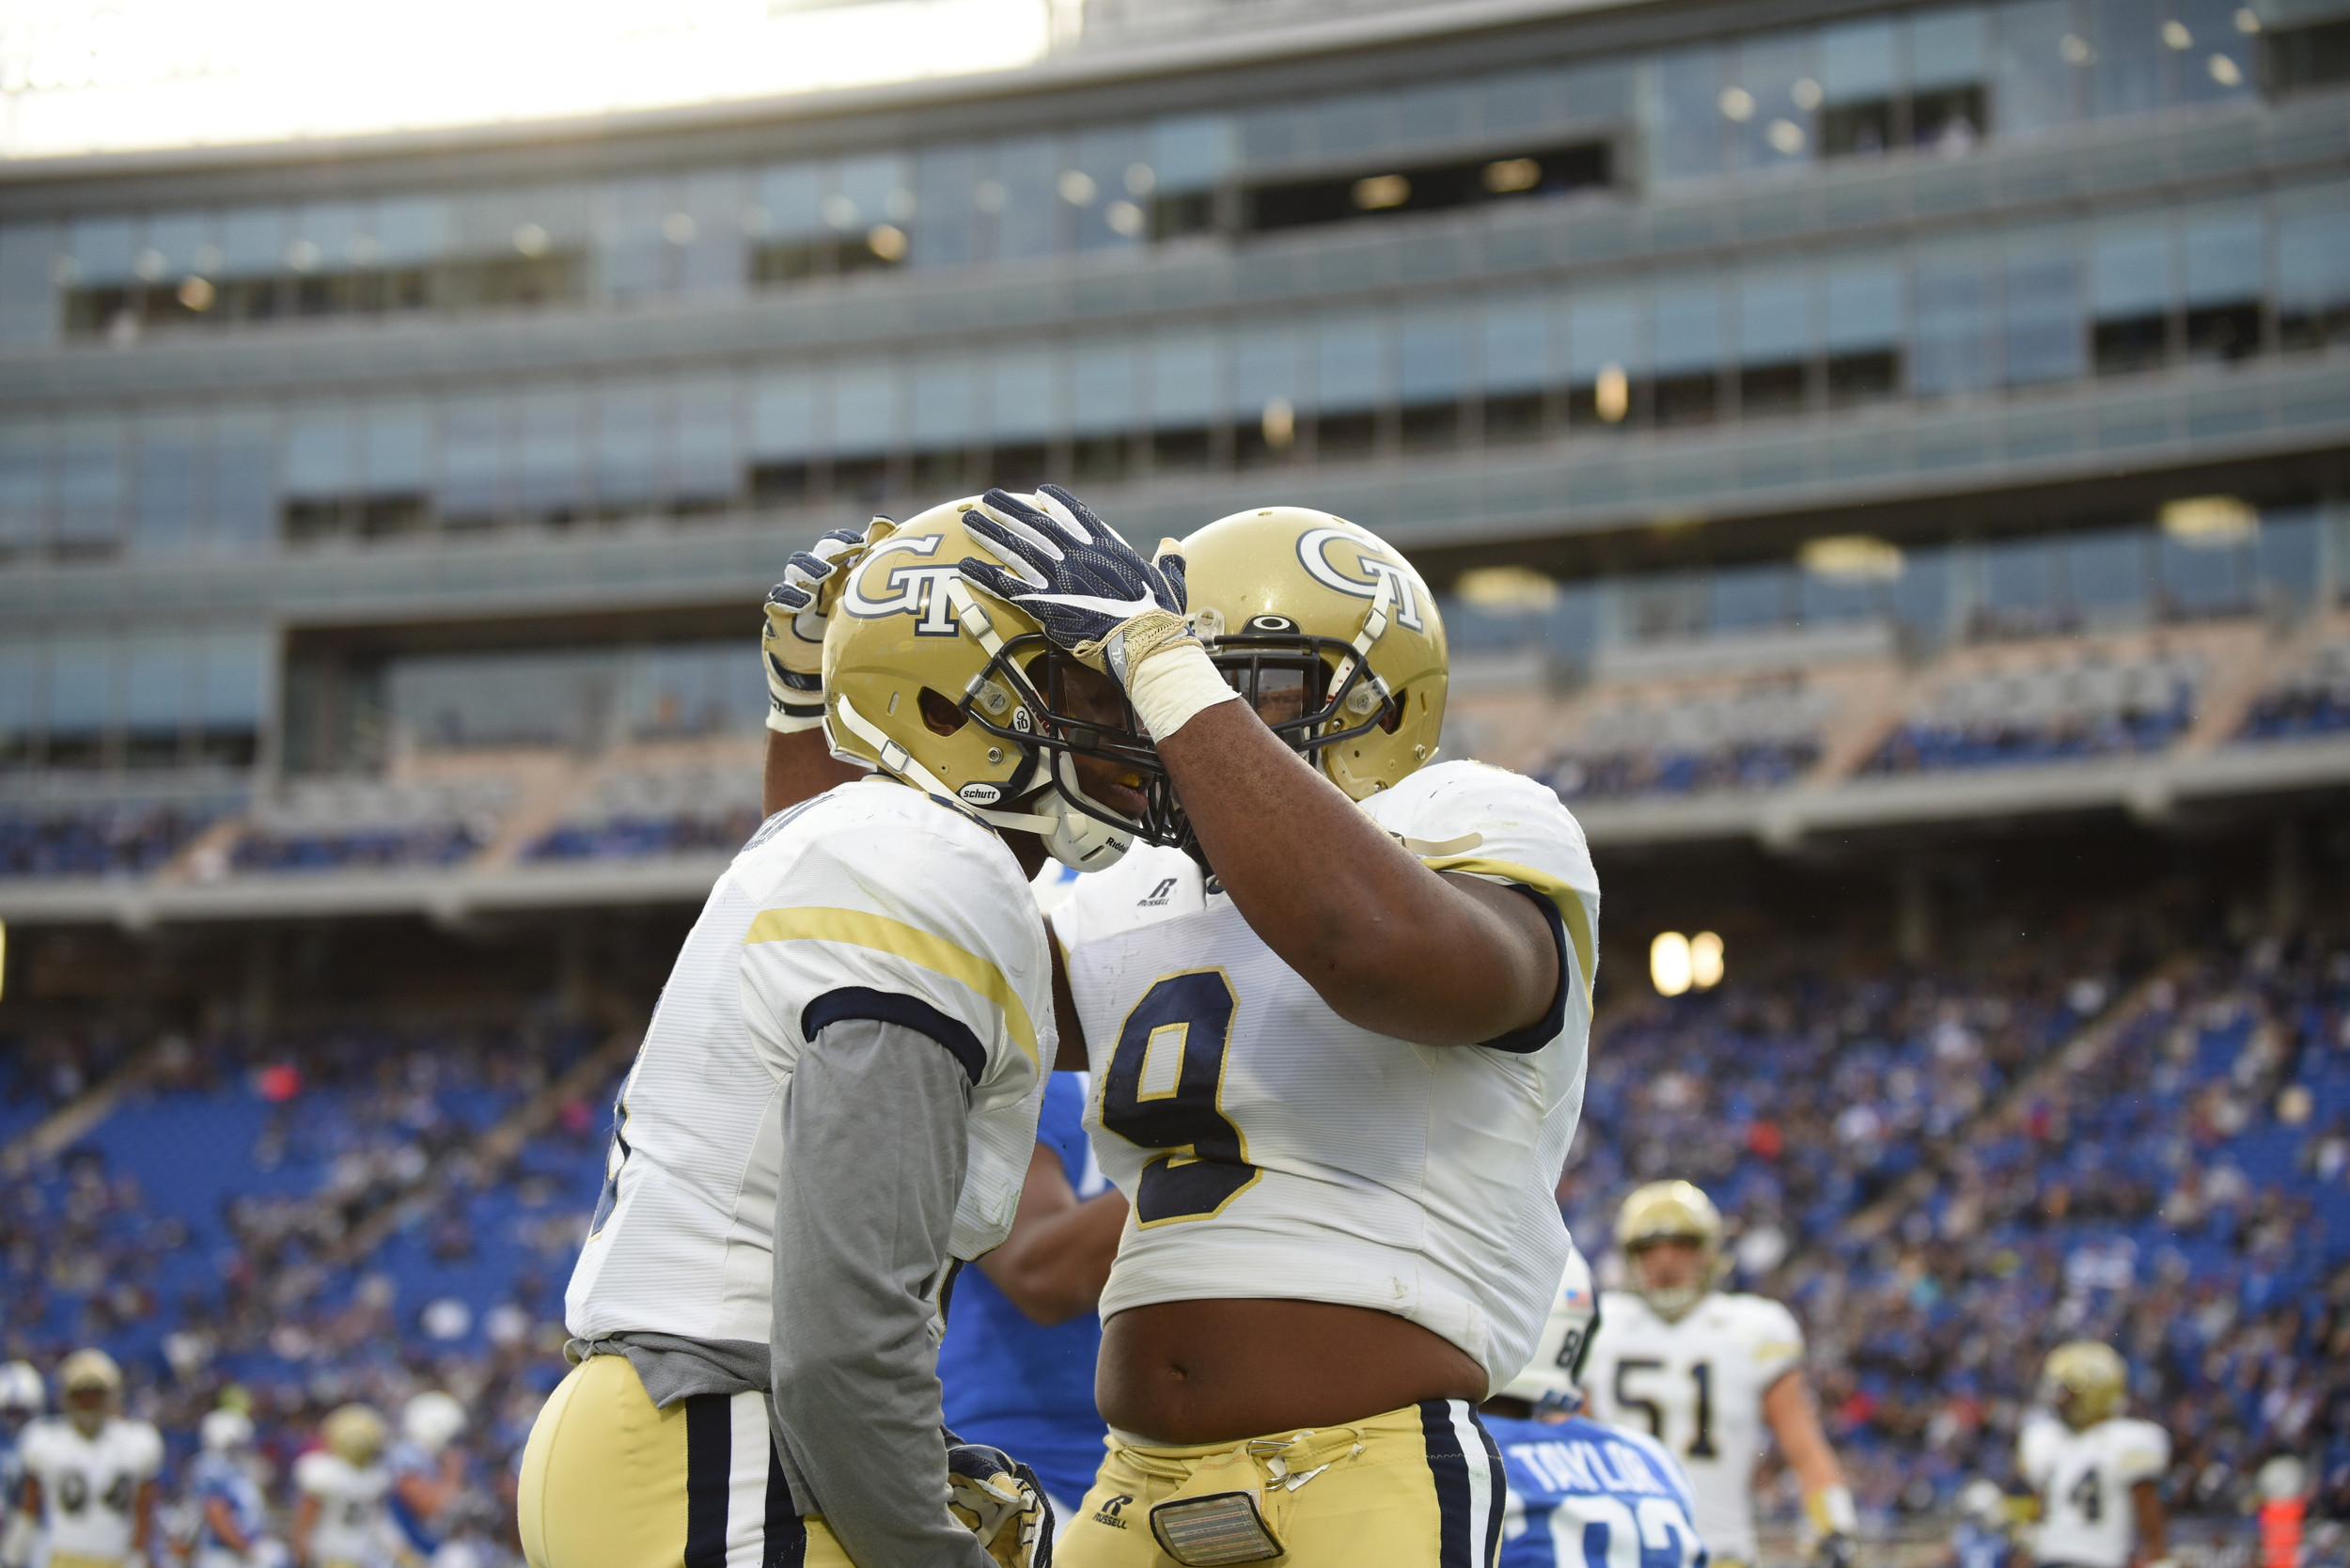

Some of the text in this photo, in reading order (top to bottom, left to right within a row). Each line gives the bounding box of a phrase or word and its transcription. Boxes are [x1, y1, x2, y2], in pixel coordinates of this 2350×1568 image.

[842, 534, 1006, 637] GT
[1295, 527, 1433, 635] GT
[1111, 647, 1124, 666] XL
[1016, 718, 1028, 729] 10
[963, 788, 997, 799] schutt
[1099, 965, 1263, 1231] 9
[1613, 1358, 1718, 1460] 51
[1507, 1439, 1668, 1496] TAYLOR
[1092, 1512, 1128, 1530] RUSSELL
